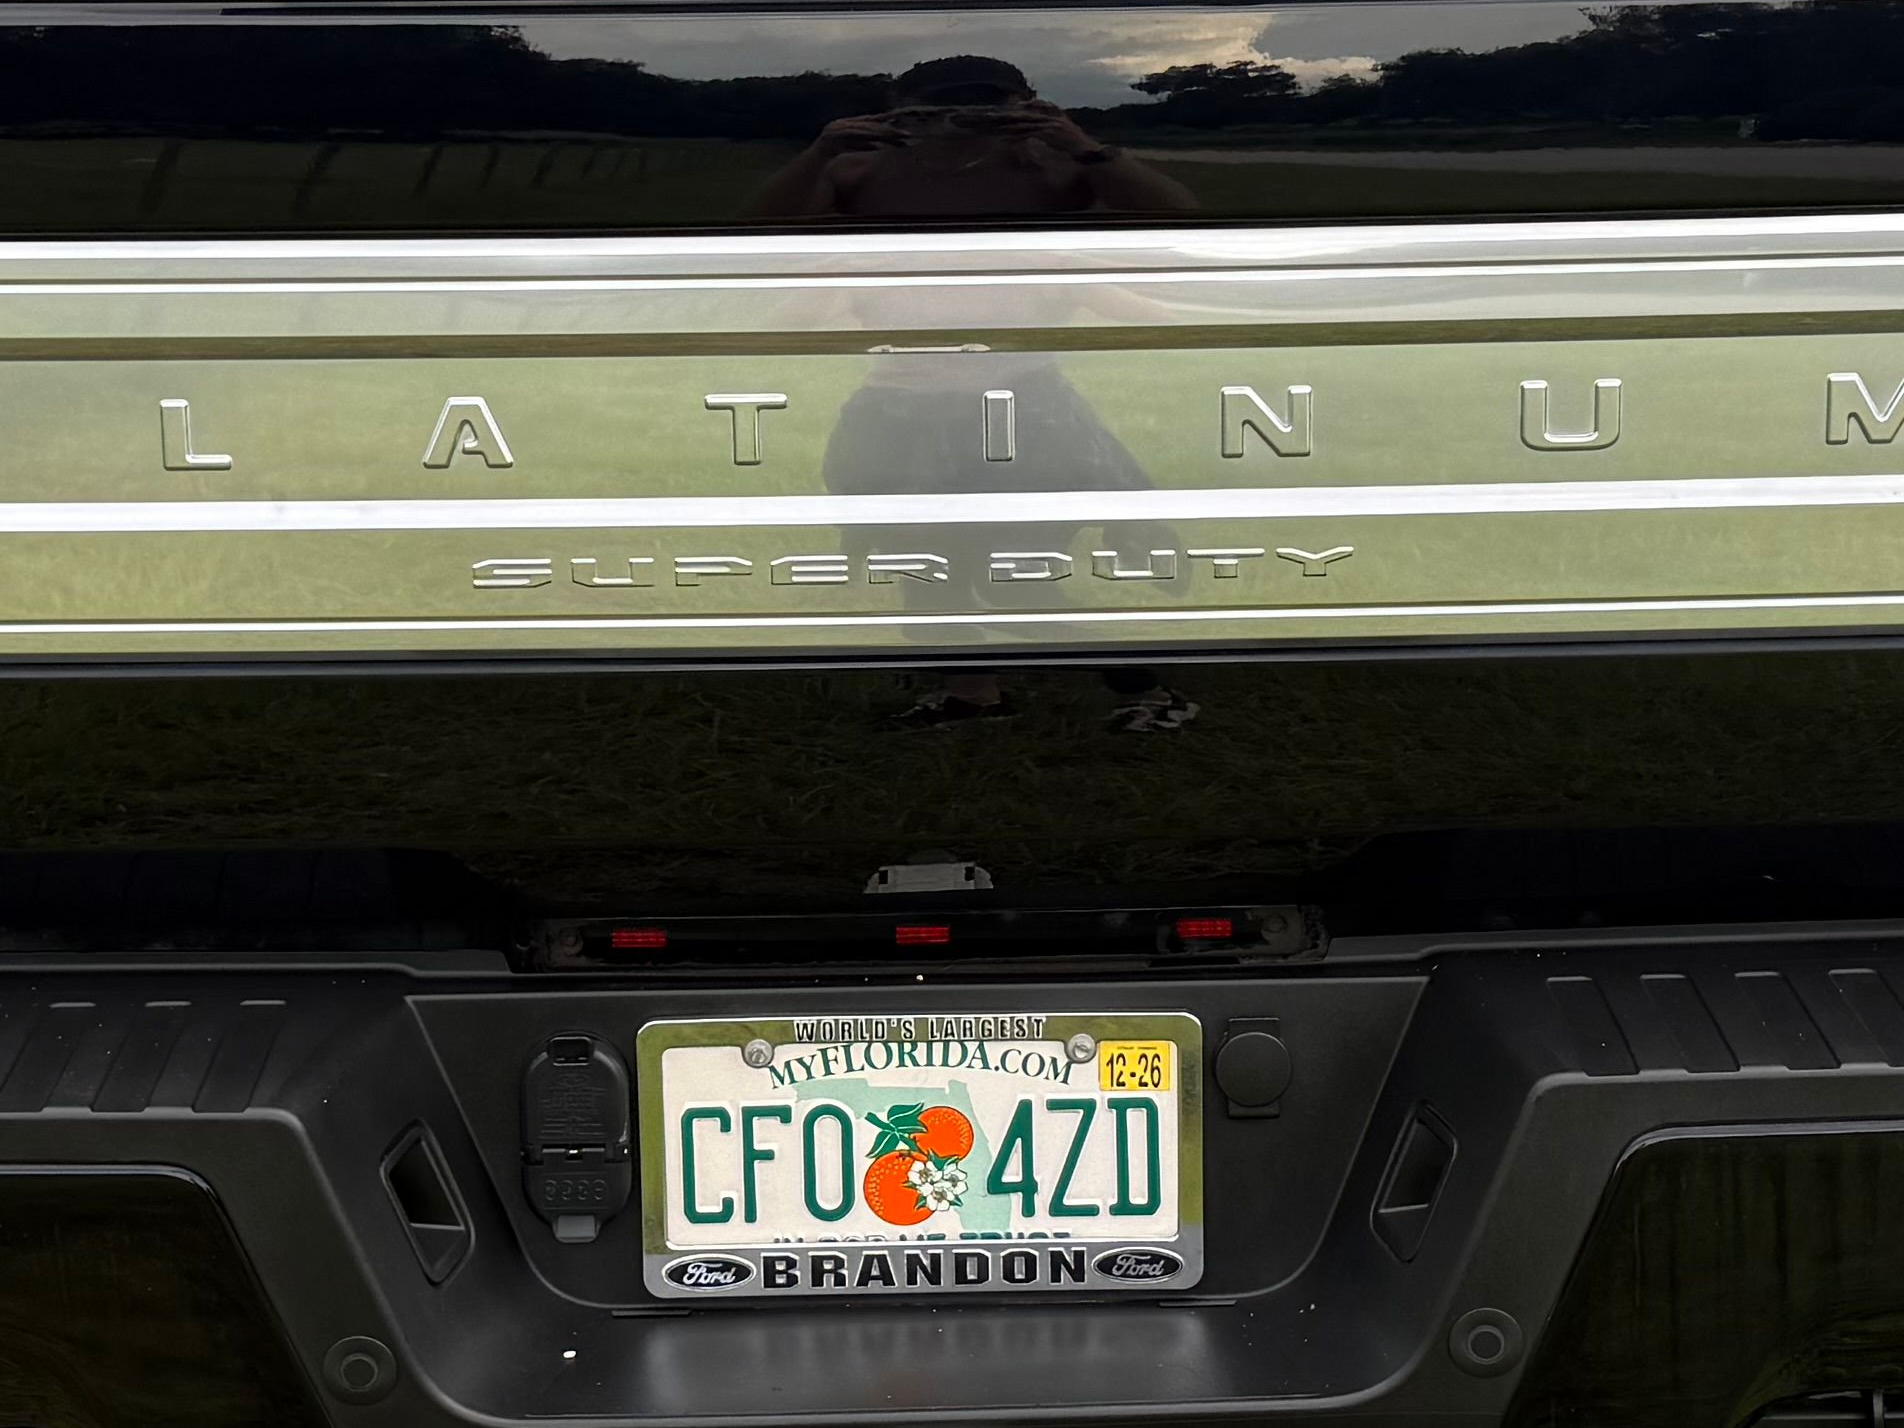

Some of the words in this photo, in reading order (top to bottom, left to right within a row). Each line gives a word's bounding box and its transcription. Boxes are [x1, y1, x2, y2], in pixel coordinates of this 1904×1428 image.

[471, 553, 949, 589] SUPER
[989, 546, 1355, 583] DUTY
[795, 1018, 915, 1042] WORLD'S
[928, 1016, 1046, 1040] LARGEST
[1106, 1053, 1161, 1088] 12-26
[985, 1097, 1162, 1218] 4ZD
[682, 1260, 736, 1286] Ford
[760, 1246, 1089, 1291] BRANDON
[1111, 1254, 1165, 1280] Ford
